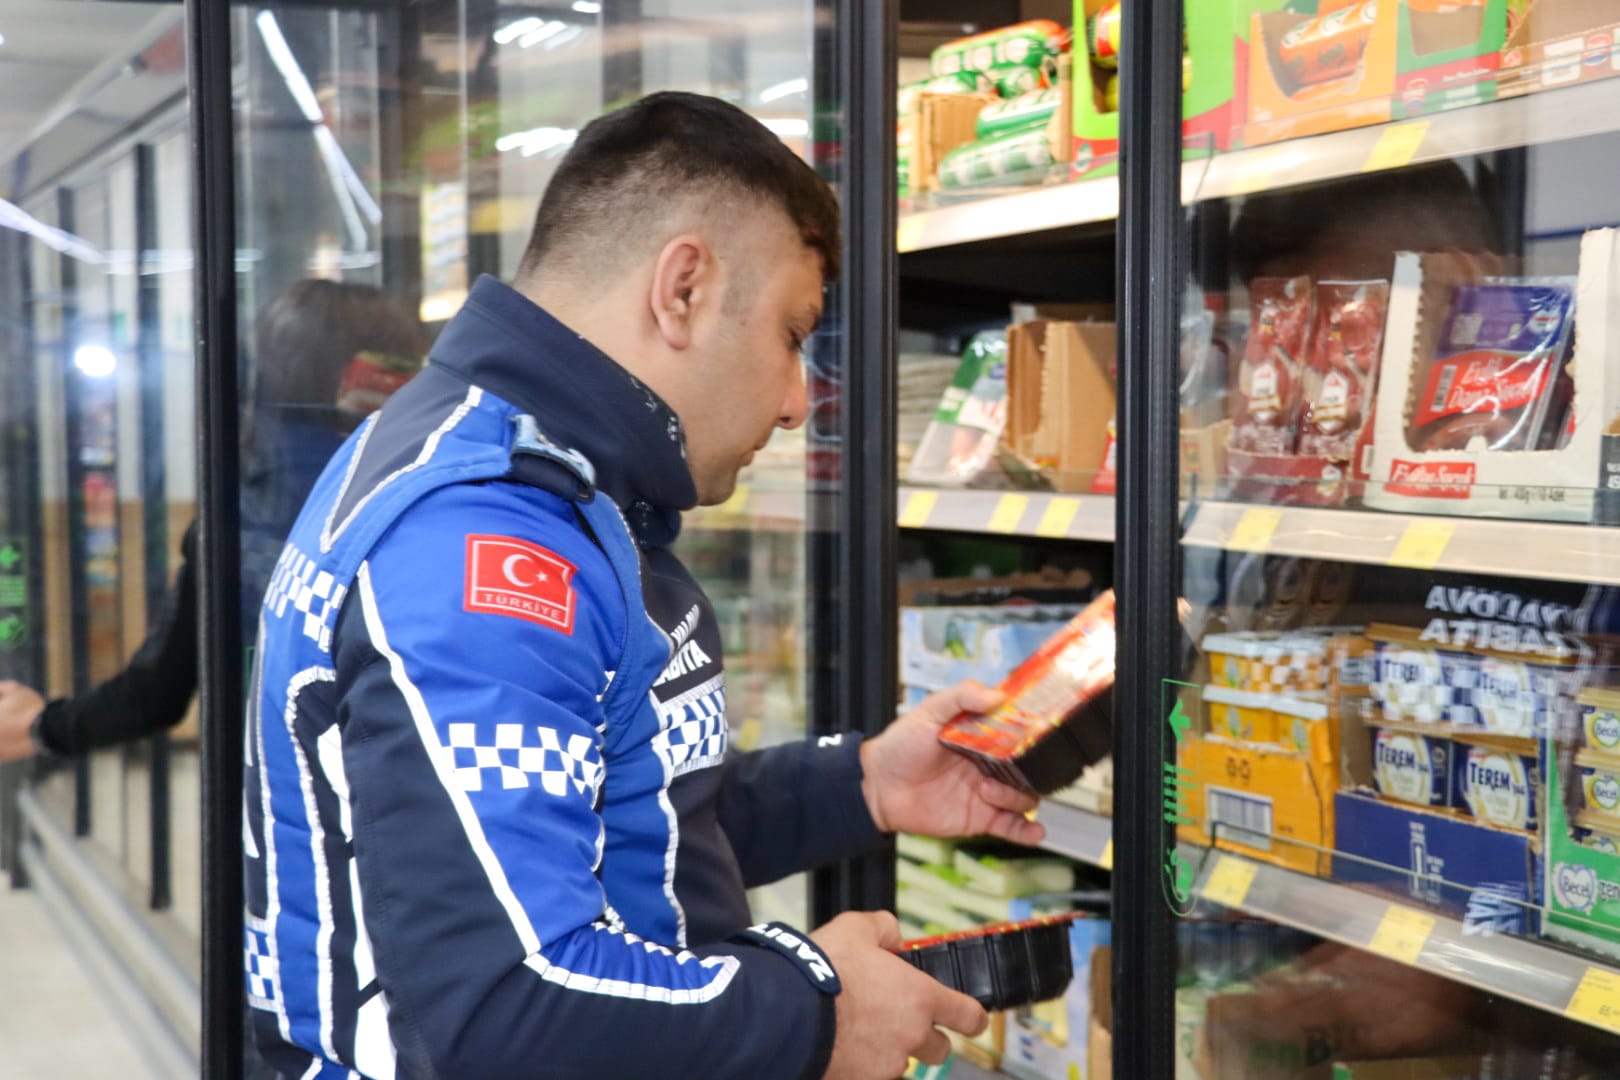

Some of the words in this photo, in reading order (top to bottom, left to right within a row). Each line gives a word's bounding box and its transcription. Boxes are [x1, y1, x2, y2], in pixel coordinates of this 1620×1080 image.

[484, 594, 561, 619] TÜRKİYE
[652, 639, 712, 687] ABITA
[1378, 742, 1416, 769] TEREM
[1469, 762, 1511, 791] TEREM
[746, 923, 835, 981] ZABIT
